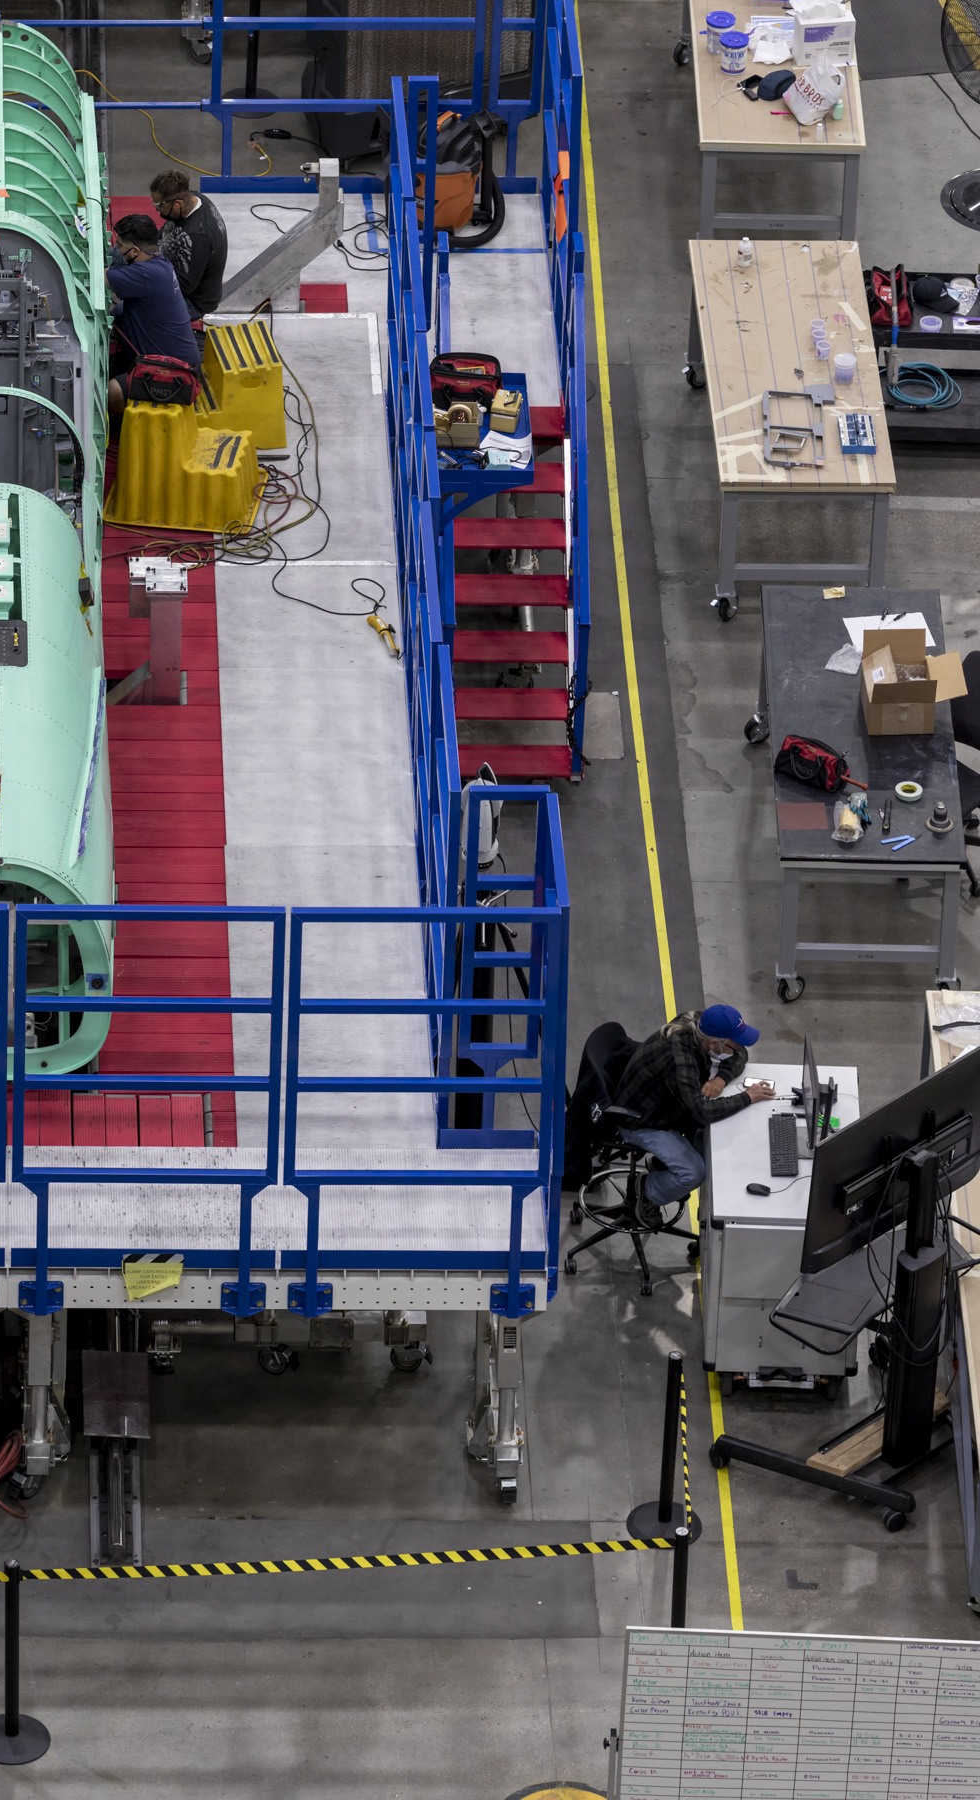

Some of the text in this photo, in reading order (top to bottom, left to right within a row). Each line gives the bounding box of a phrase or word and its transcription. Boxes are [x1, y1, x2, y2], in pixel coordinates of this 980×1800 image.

[803, 84, 826, 106] BROS
[661, 1633, 697, 1644] Action
[700, 1634, 728, 1646] Board
[690, 1649, 731, 1658] Action item
